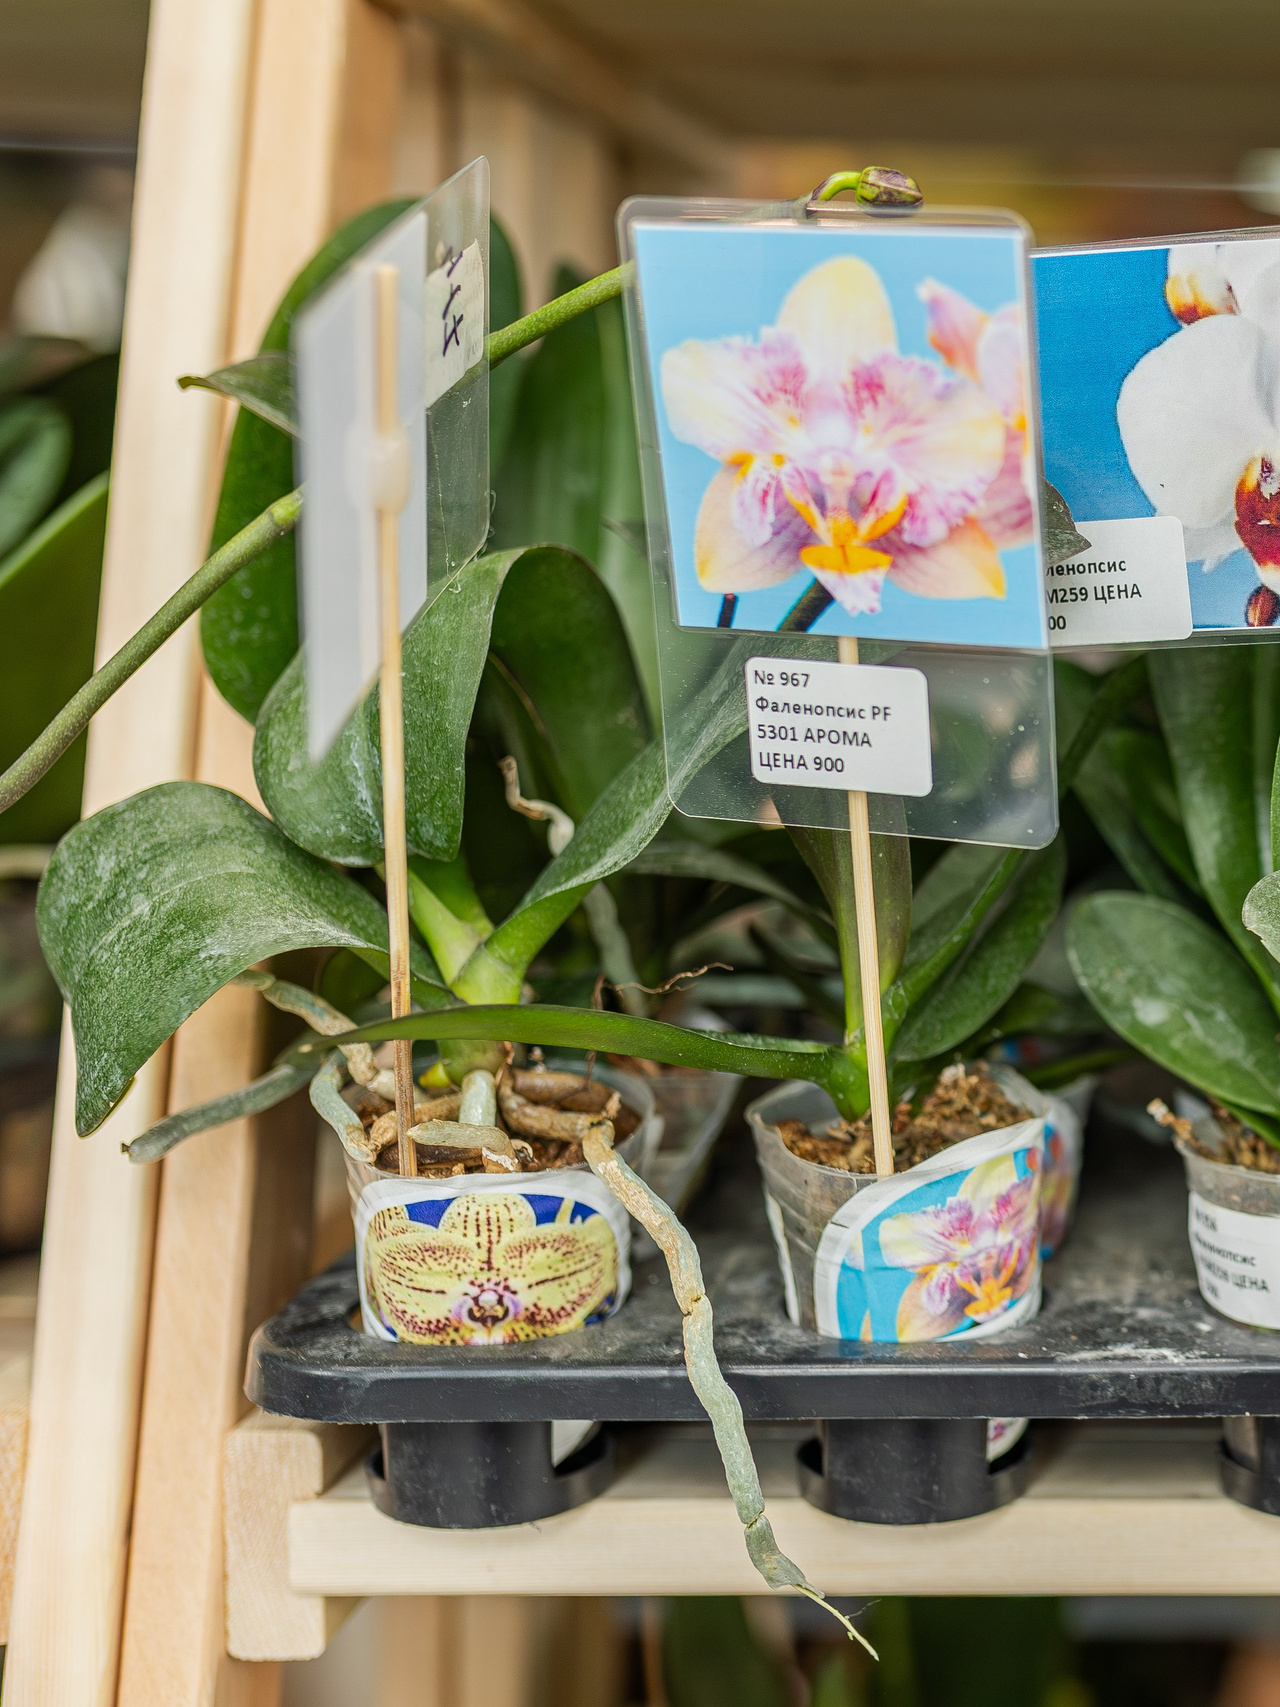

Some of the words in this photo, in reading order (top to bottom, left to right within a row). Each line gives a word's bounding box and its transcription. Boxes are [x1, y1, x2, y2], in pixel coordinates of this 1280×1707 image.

[1046, 560, 1127, 577] ленопсис
[1094, 583, 1143, 605] ЦЕНА
[1048, 615, 1067, 631] 00
[754, 670, 776, 686] №
[780, 671, 811, 688] 967
[755, 696, 867, 720] Фаленопсис
[757, 723, 799, 742] 5301
[804, 727, 873, 748] АРОМА
[759, 751, 809, 772] ЦЕНА
[813, 756, 845, 773] 900
